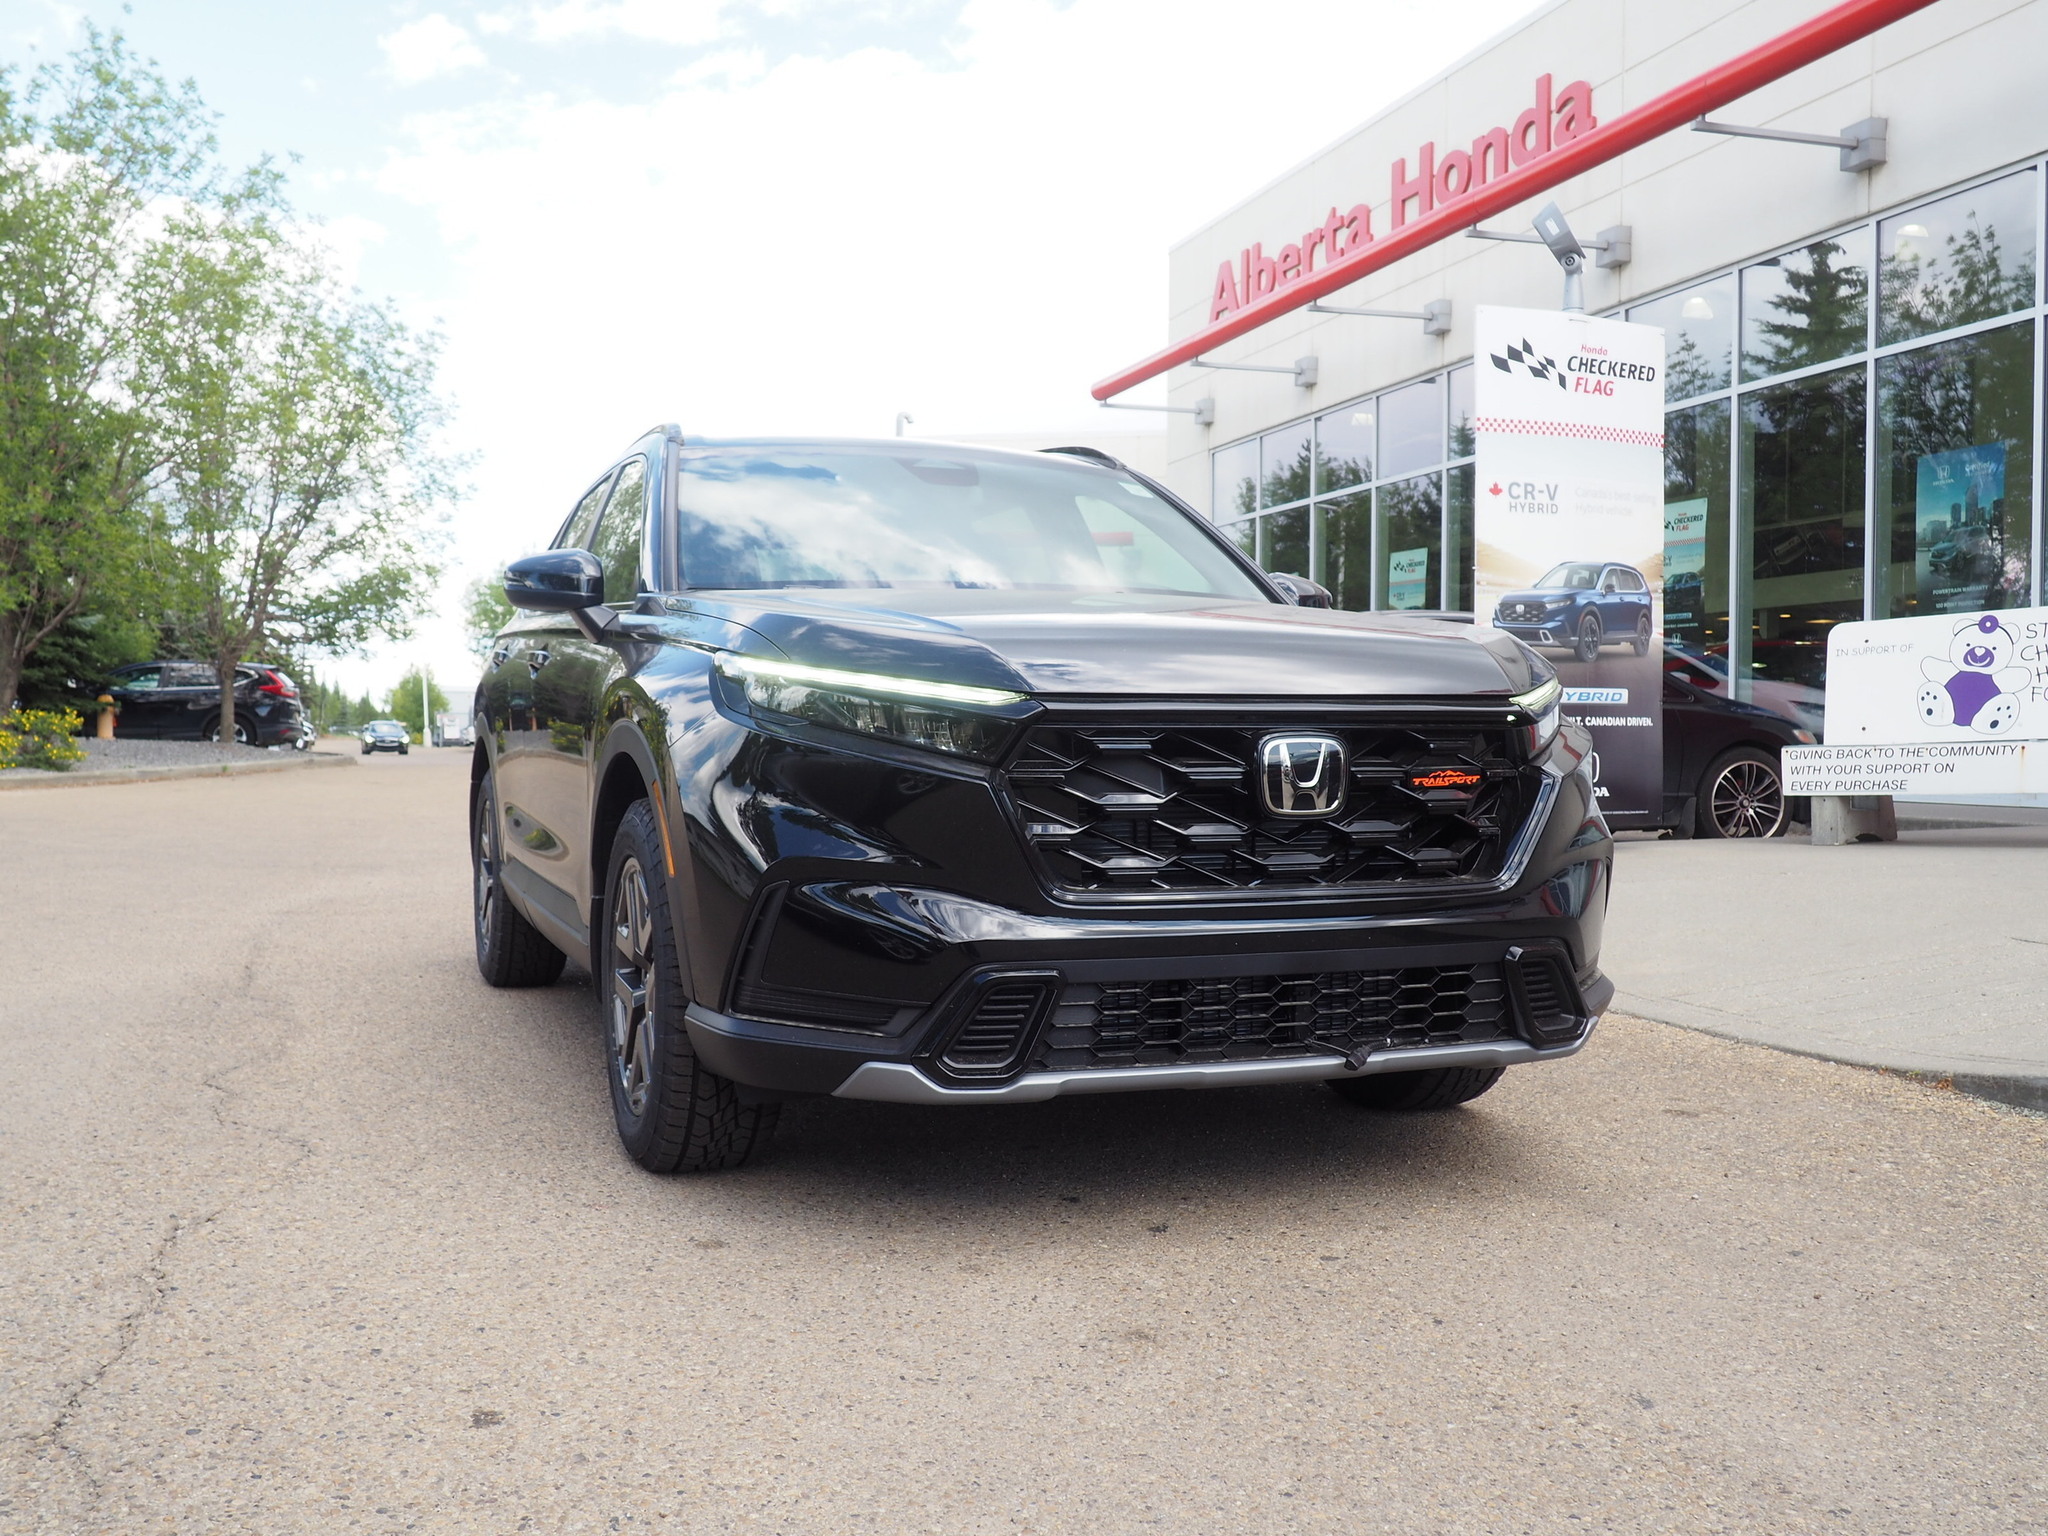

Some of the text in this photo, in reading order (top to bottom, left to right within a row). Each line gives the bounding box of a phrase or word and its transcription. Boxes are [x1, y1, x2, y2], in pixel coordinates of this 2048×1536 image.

[1209, 73, 1597, 323] Alberta Honda
[1580, 344, 1608, 356] Honda
[1567, 356, 1656, 382] CHECKERED
[1574, 377, 1615, 397] FLAG
[1508, 481, 1559, 501] CR-V
[1508, 502, 1559, 515] HYBRID
[1836, 644, 1914, 657] IN SUPPORT OF
[1565, 691, 1623, 702] YBRID
[1585, 716, 1626, 727] CANADIAN
[1627, 716, 1654, 727] DRIVEN.
[1789, 744, 2019, 760] GIVING BACK TO THE COMMUNITY
[1790, 762, 1955, 776] WITH YOUR SUPPORT ON
[1412, 775, 1482, 787] TRAILSPORT
[1790, 779, 1909, 792] EVERY PURCHASE
